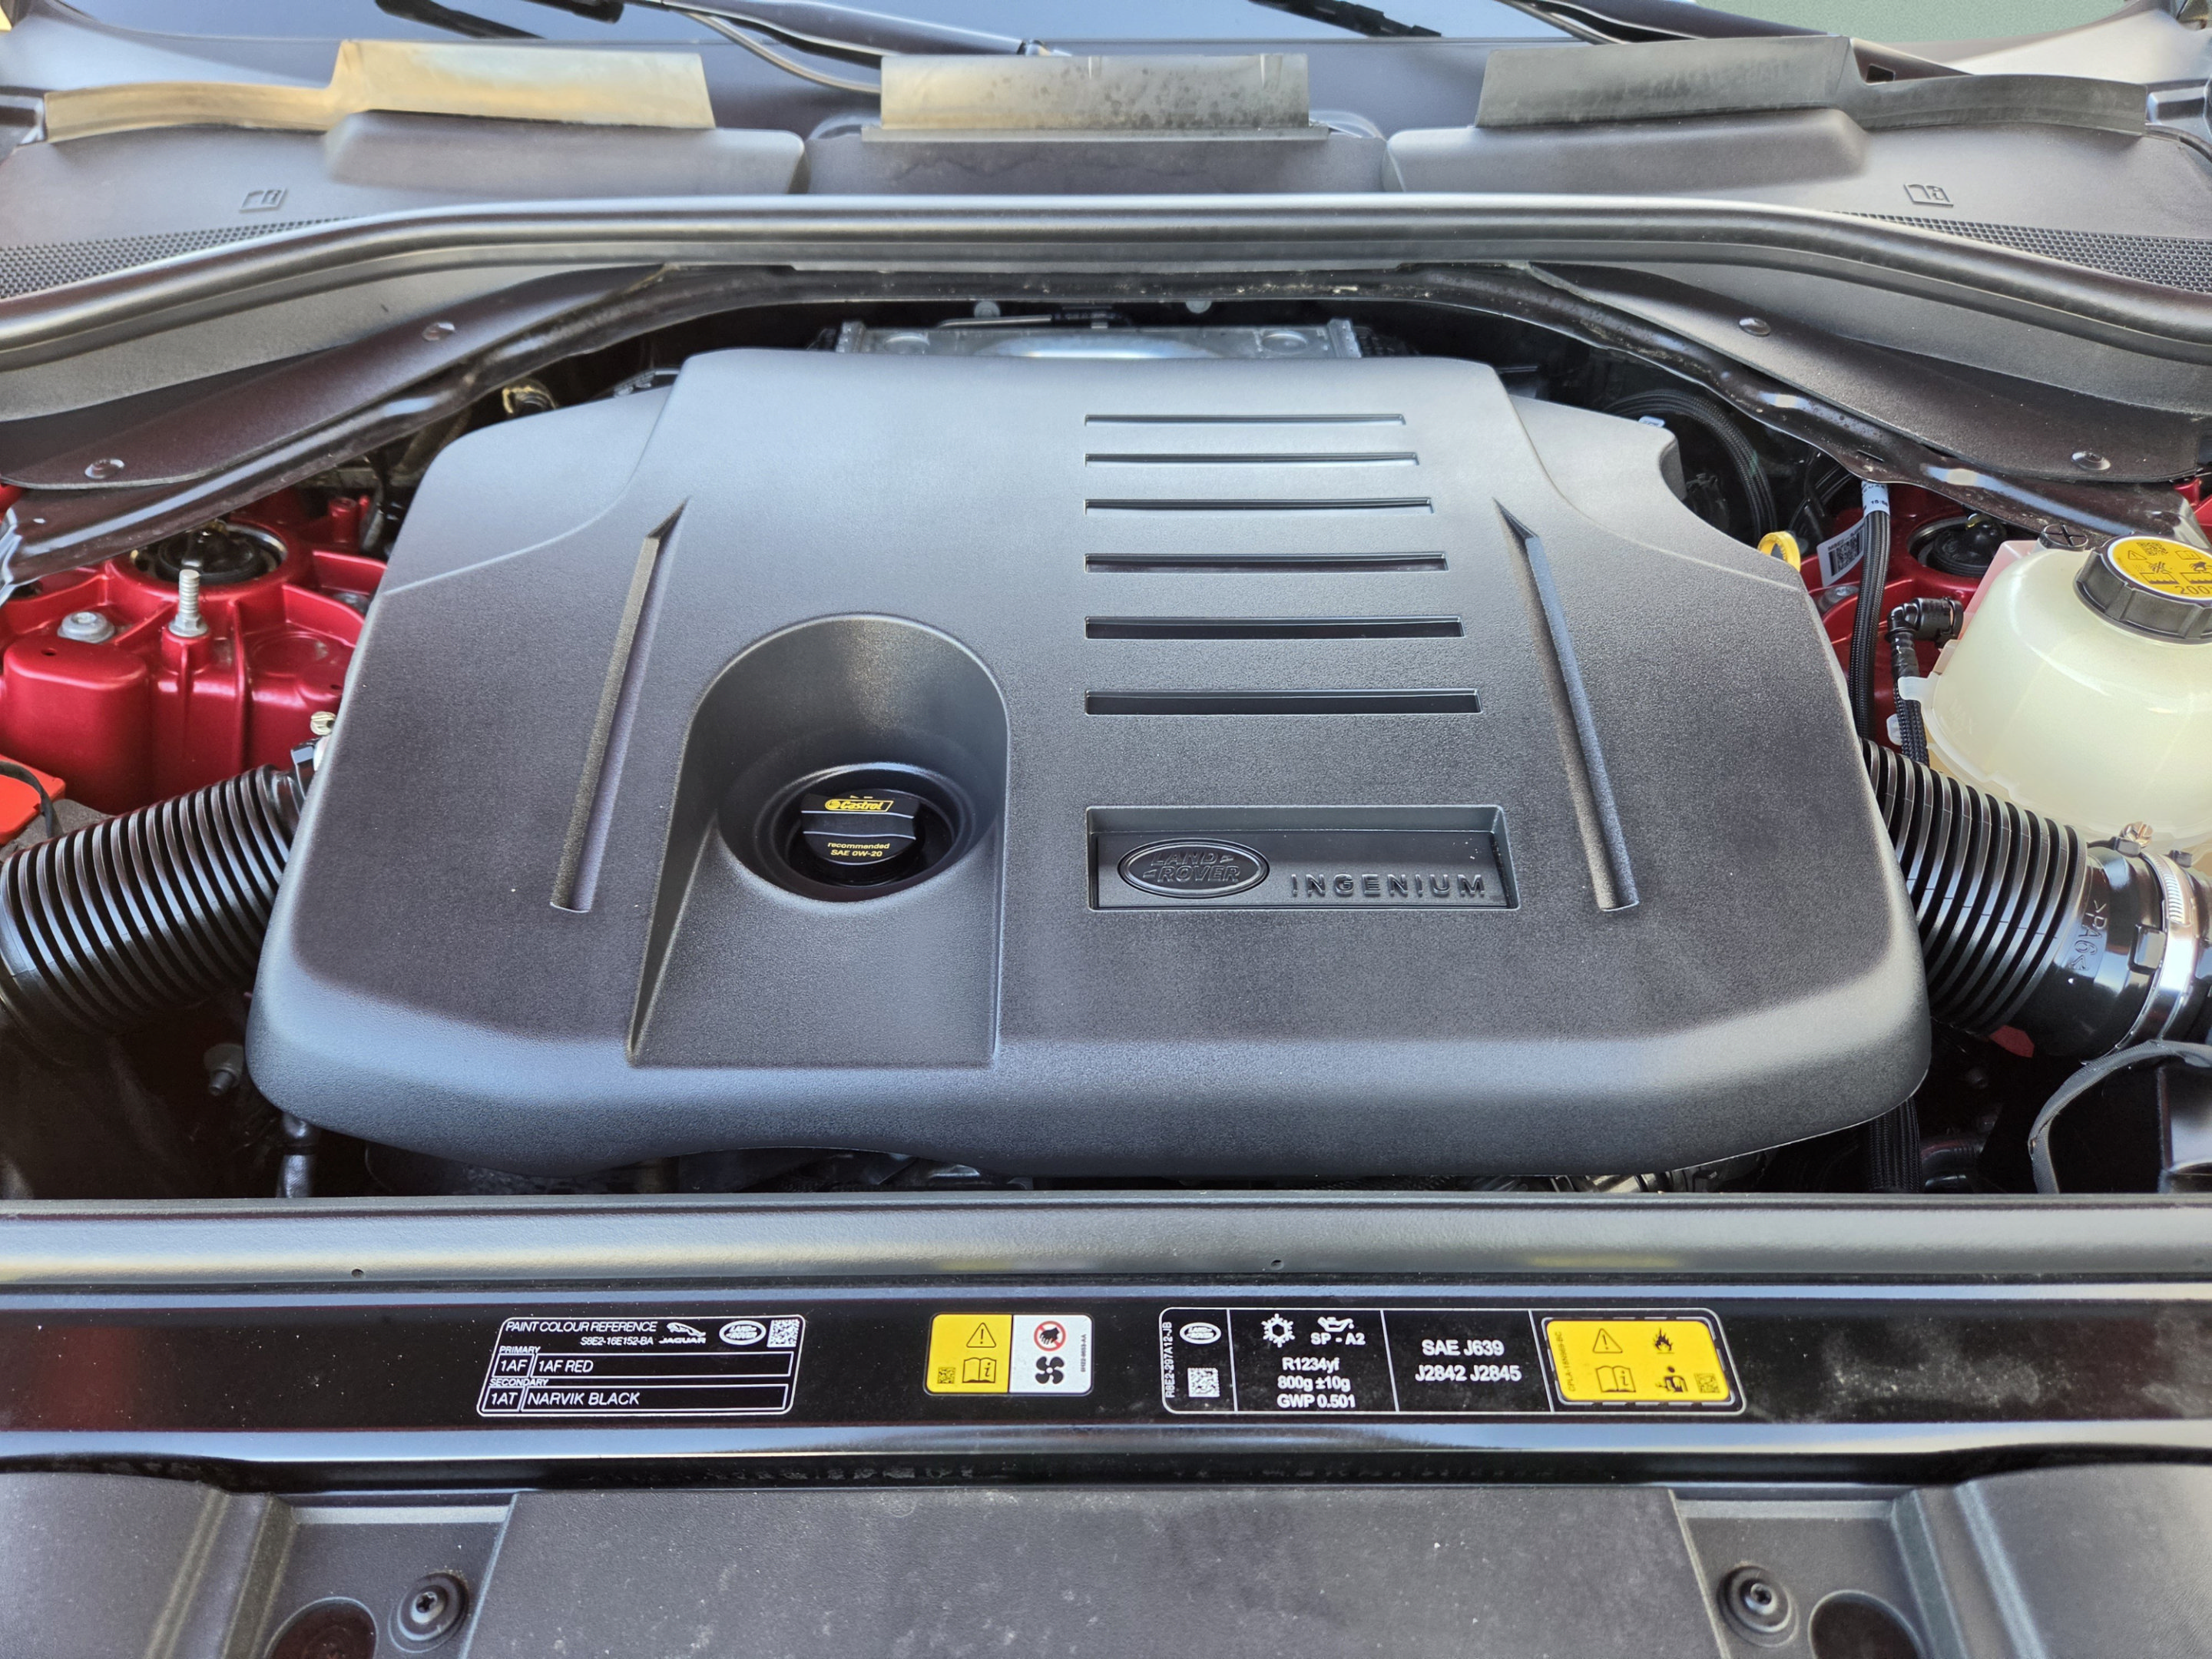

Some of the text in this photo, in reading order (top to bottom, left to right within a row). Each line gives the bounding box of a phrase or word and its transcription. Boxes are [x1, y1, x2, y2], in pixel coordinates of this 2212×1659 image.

[2174, 585, 2212, 595] 200
[840, 800, 882, 810] Castrol
[1151, 849, 1217, 866] LAND
[1157, 865, 1241, 883] ROVER
[1290, 873, 1487, 899] INGENIUM
[505, 1321, 657, 1333] PAINT COLOUR REFERENCE
[1310, 1333, 1332, 1345] SP
[1345, 1333, 1366, 1345] A2
[1422, 1339, 1504, 1356] SAE J639
[501, 1359, 528, 1372] 1AF
[538, 1359, 594, 1373] 1AF RED
[1282, 1356, 1340, 1374] R1234yf
[1415, 1365, 1522, 1382] J2842 J2845
[1277, 1375, 1351, 1392] 800g ±10g
[491, 1392, 518, 1405] 1AT
[528, 1392, 641, 1406] NARVIK BLACK
[1277, 1393, 1356, 1409] GWP 0.501
